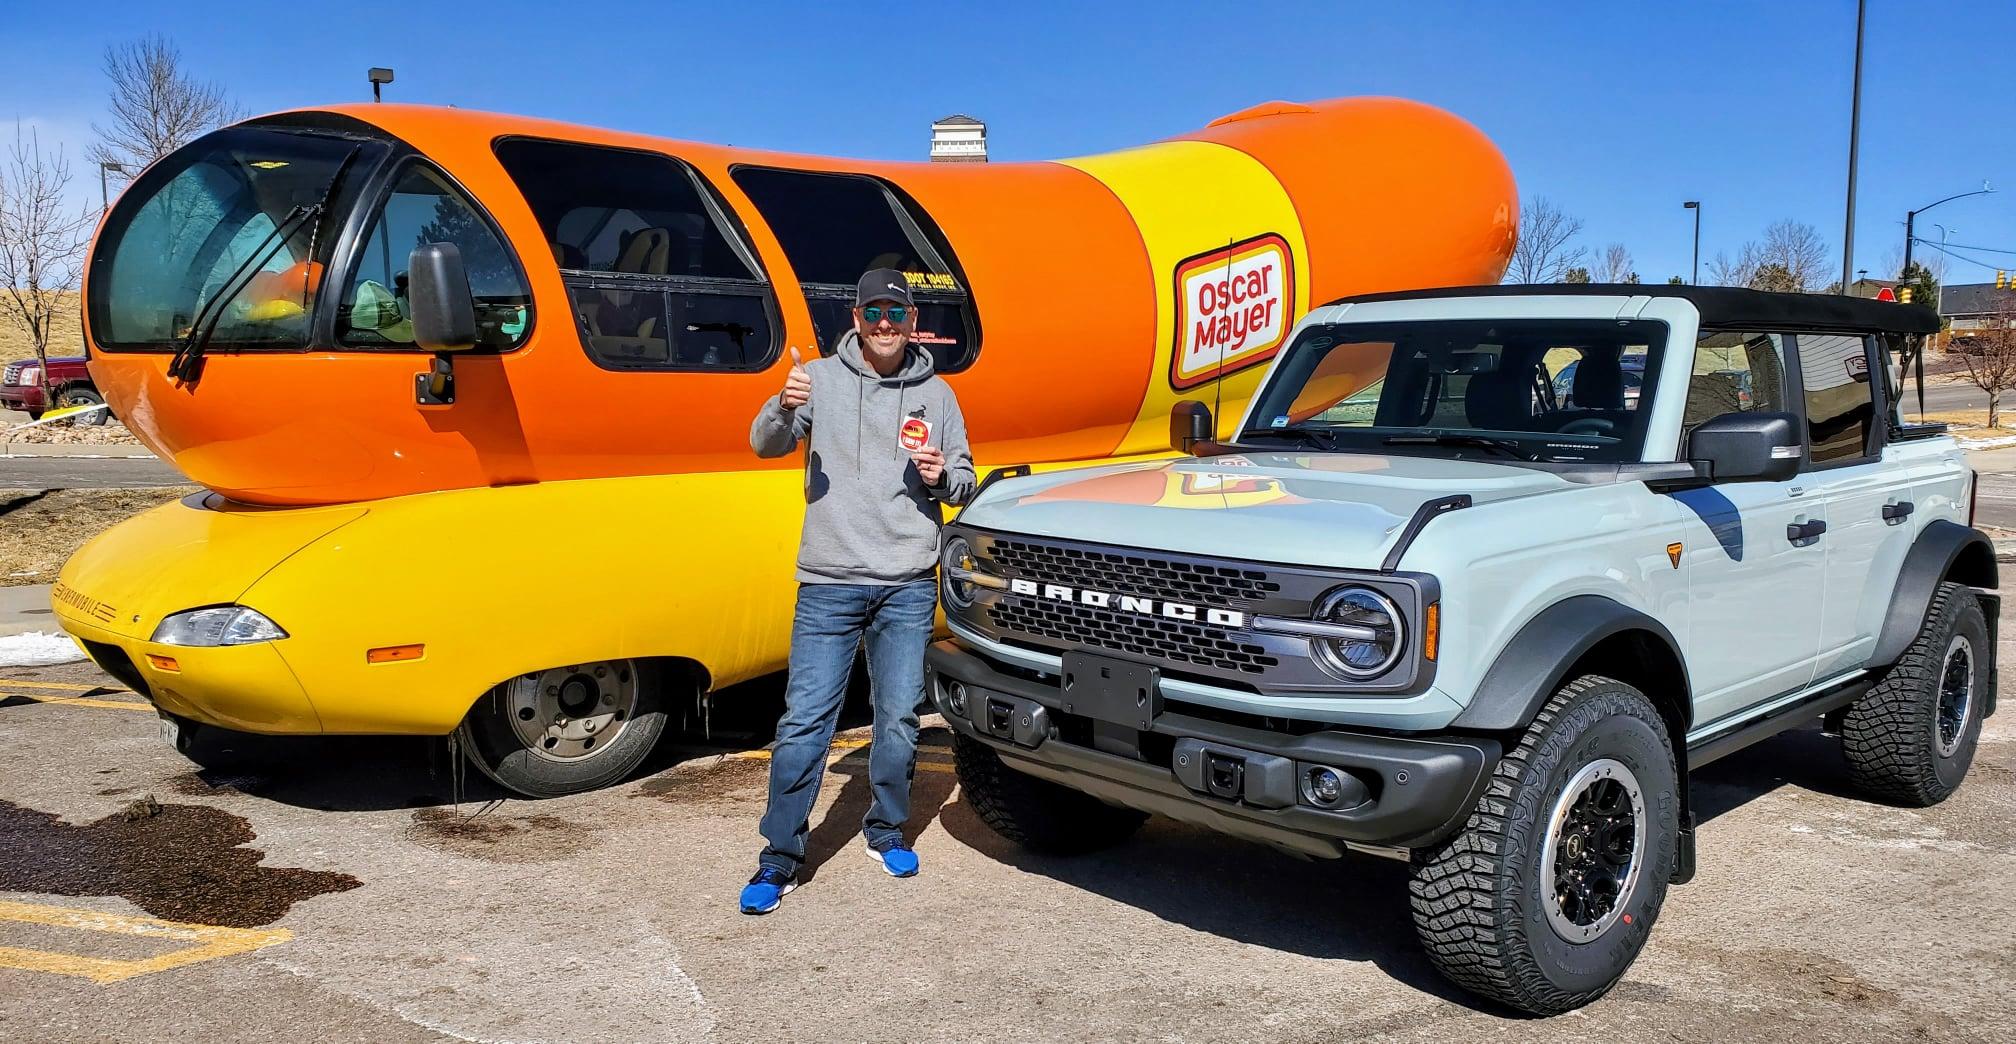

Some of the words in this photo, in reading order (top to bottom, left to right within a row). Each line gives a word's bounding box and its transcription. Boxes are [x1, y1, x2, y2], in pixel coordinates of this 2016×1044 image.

[903, 271, 926, 284] SDOT
[1199, 264, 1272, 316] Oscar
[1194, 297, 1277, 354] Mayer
[1011, 578, 1243, 628] BRONCO
